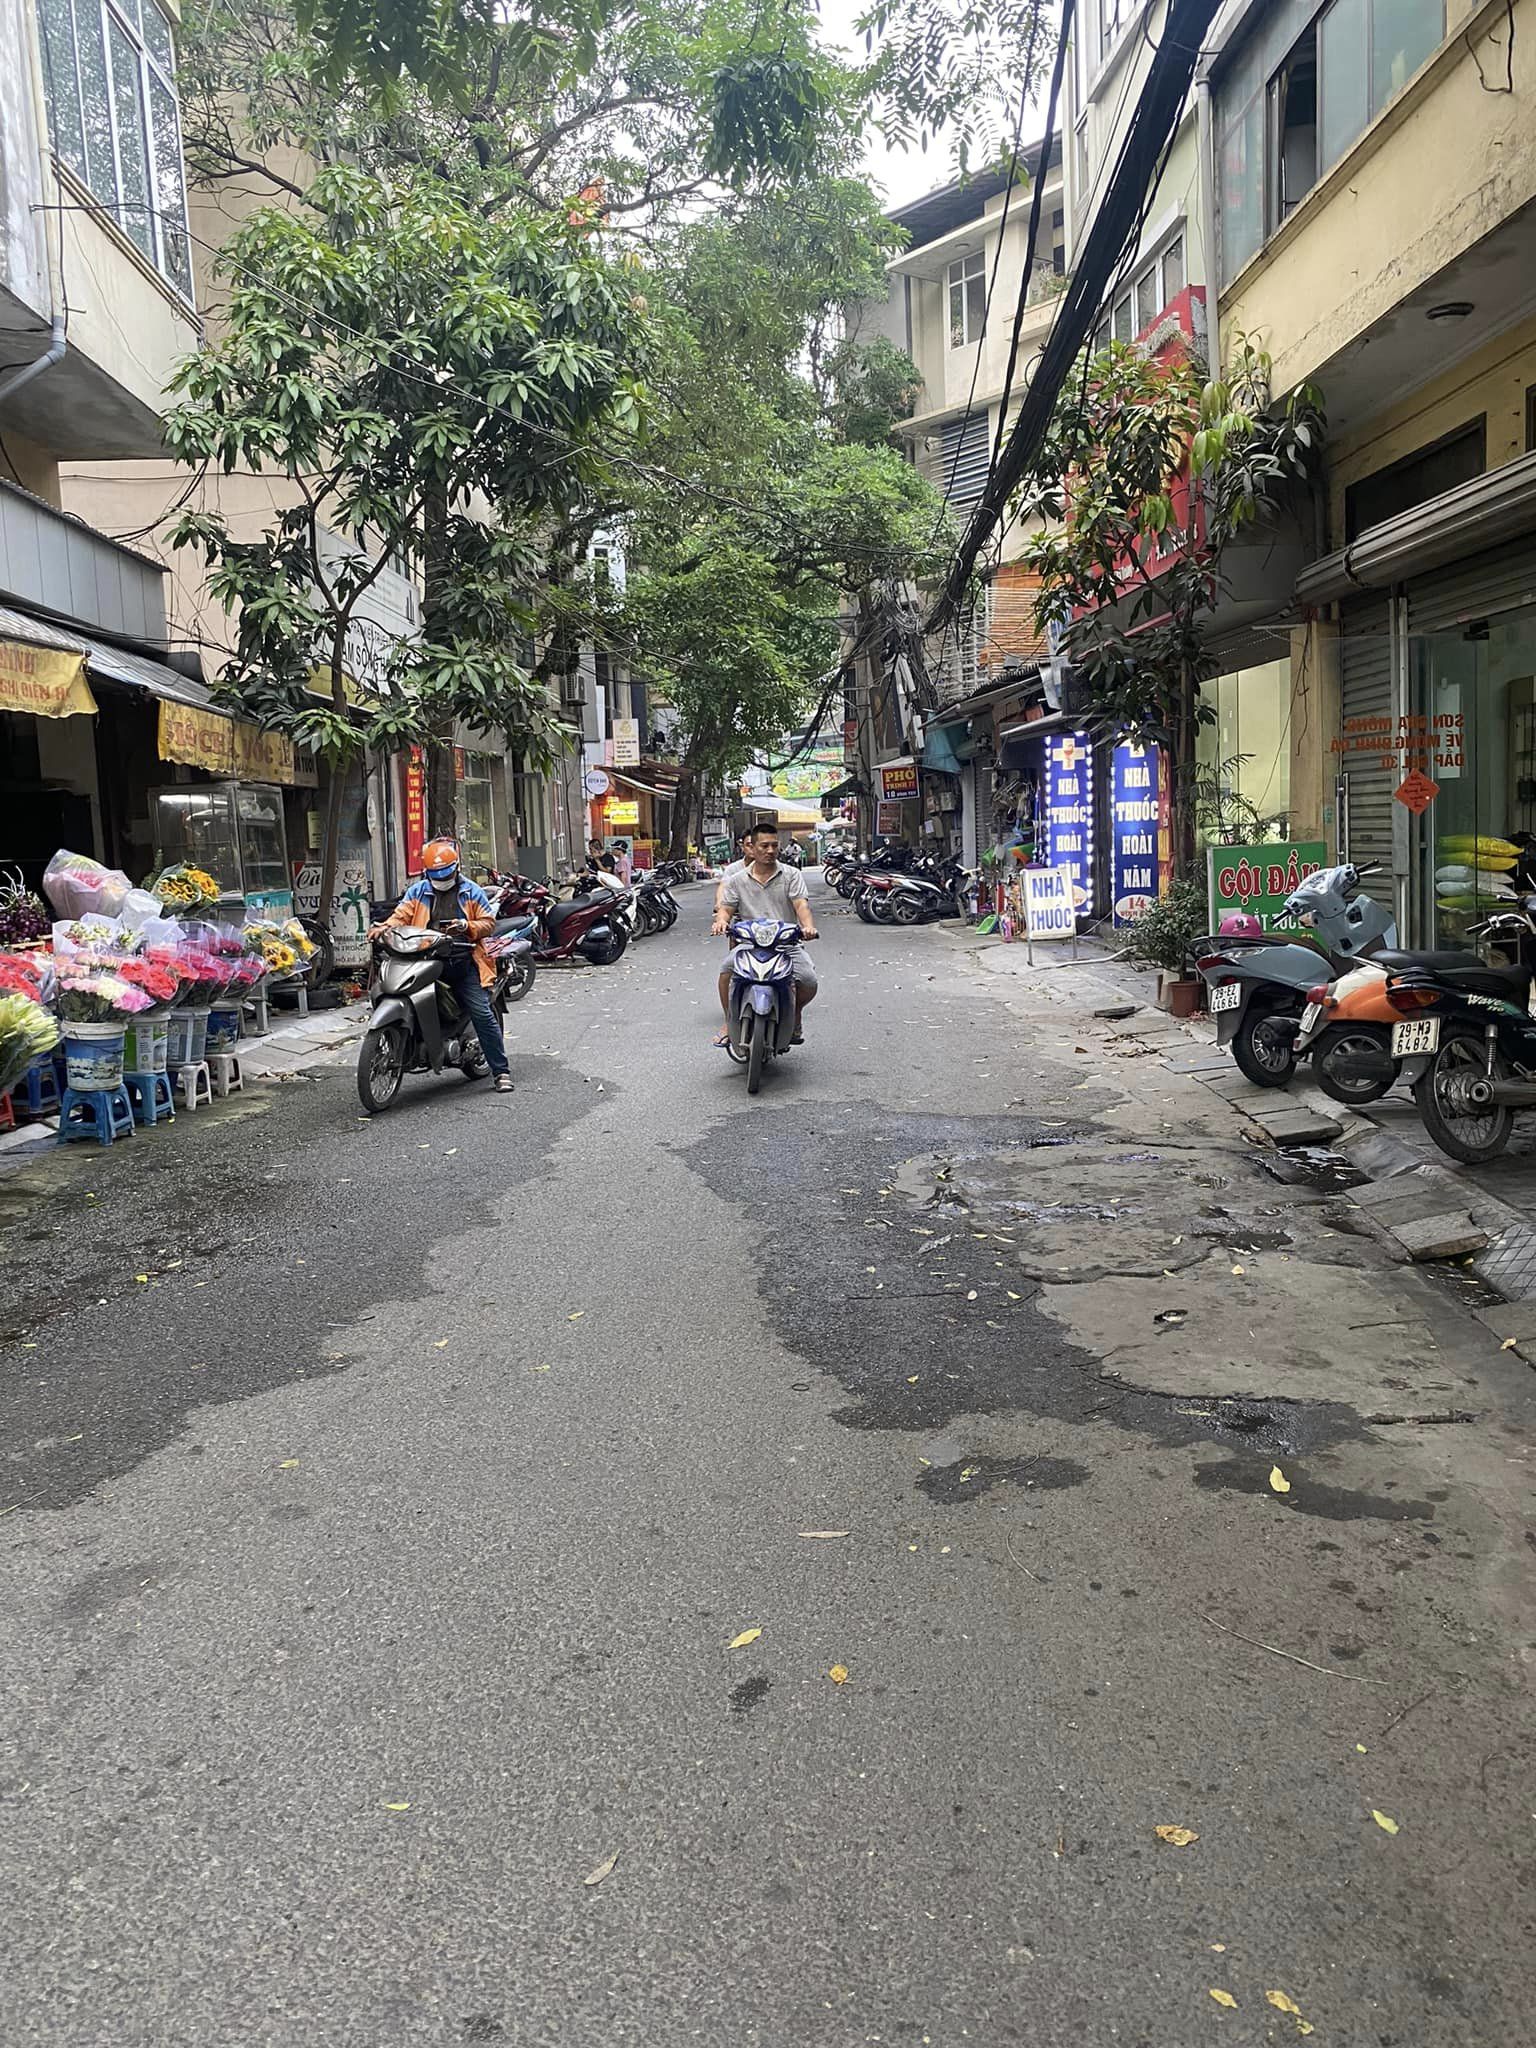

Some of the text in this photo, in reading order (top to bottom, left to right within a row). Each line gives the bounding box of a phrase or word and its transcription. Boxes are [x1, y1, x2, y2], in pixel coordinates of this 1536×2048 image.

[885, 767, 915, 783] PHỞ
[1057, 773, 1079, 795] NHÀ
[1124, 761, 1150, 788] NHÀ
[1051, 800, 1086, 824] THUỐC
[1116, 793, 1158, 822] THUỐC
[1056, 830, 1082, 851] HOÀI
[1121, 829, 1153, 855] HOÀI
[1032, 871, 1065, 898] NHÀ
[1218, 857, 1262, 906] GỘI
[1128, 895, 1146, 909] 14
[1467, 993, 1503, 1006] Wave
[1397, 1037, 1429, 1054] 6482
